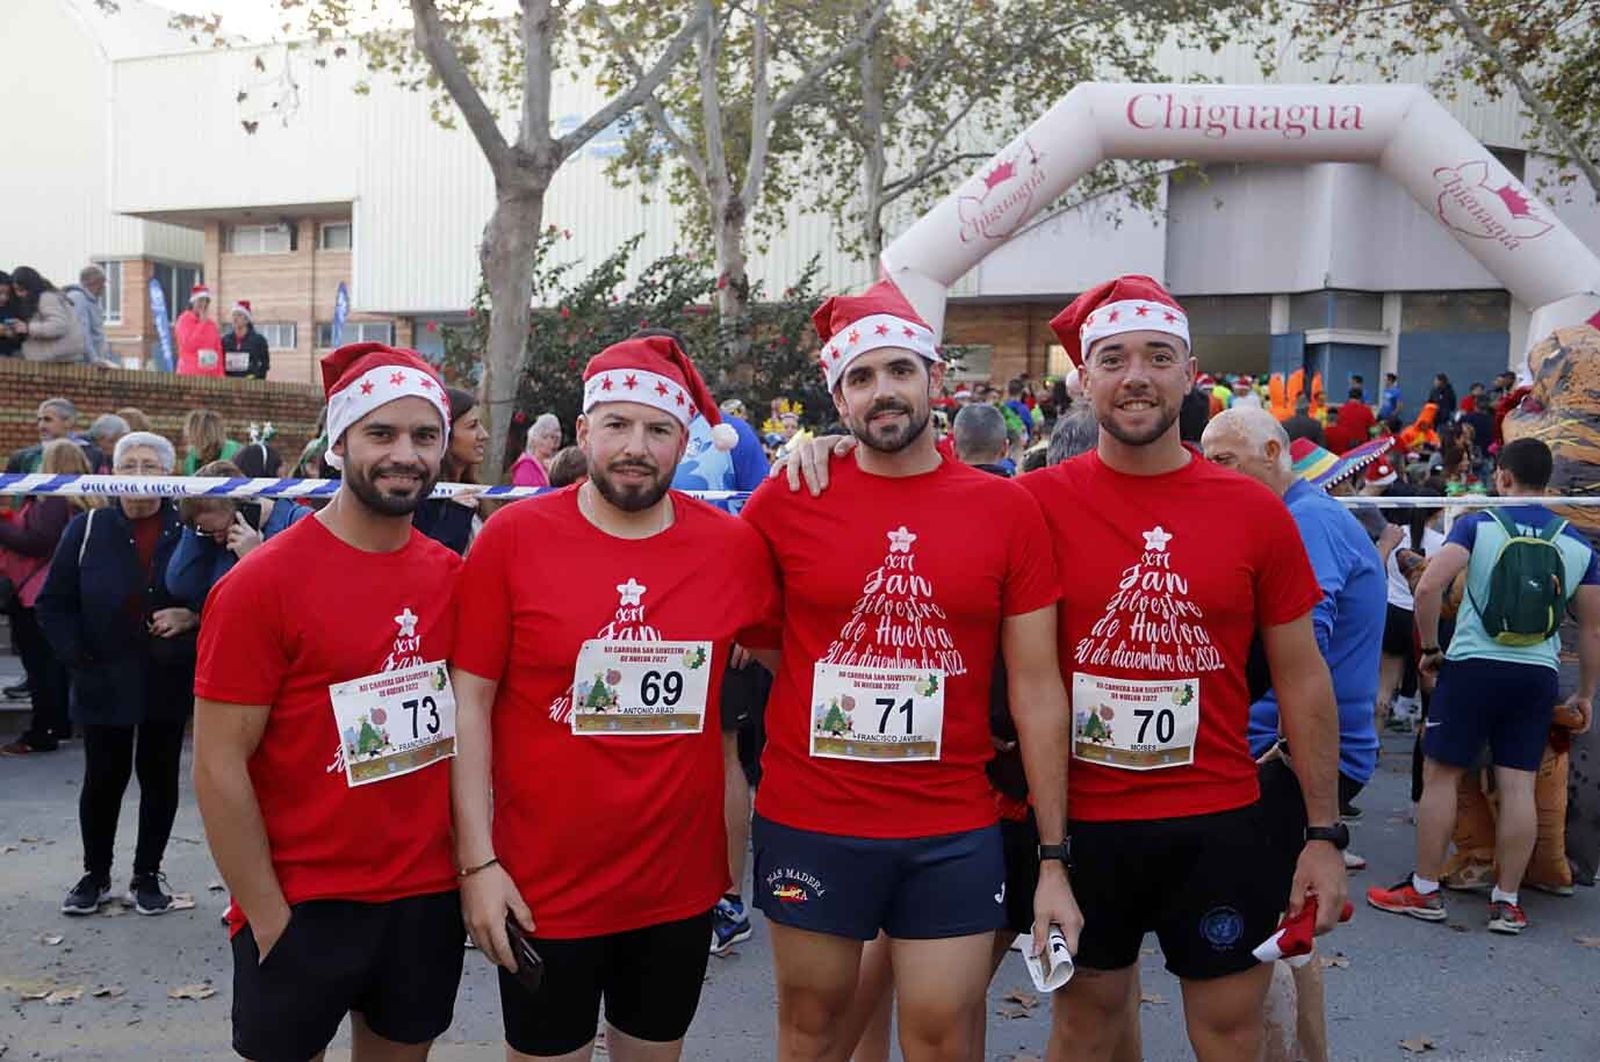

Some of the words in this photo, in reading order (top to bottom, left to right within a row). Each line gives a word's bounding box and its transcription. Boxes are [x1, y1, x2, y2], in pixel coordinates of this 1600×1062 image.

[1126, 92, 1365, 139] Chiguagua
[863, 566, 932, 597] San
[1119, 564, 1188, 595] San
[852, 593, 946, 622] Silvestre
[1106, 589, 1202, 620] Silvestre
[840, 612, 867, 642] de
[876, 615, 954, 649] Huelva
[1091, 609, 1120, 638] de
[1129, 613, 1210, 644] Huelva
[1090, 639, 1110, 665] de
[1111, 640, 1174, 672] diciembre
[1177, 644, 1195, 672] de
[640, 670, 684, 707] 69
[402, 696, 441, 739] 73
[655, 706, 675, 714] ABAD
[875, 698, 914, 735] 71
[1133, 708, 1175, 744] 70
[857, 733, 897, 742] FRANCISCO
[898, 735, 922, 743] JAVIER
[785, 868, 826, 897] MADERA
